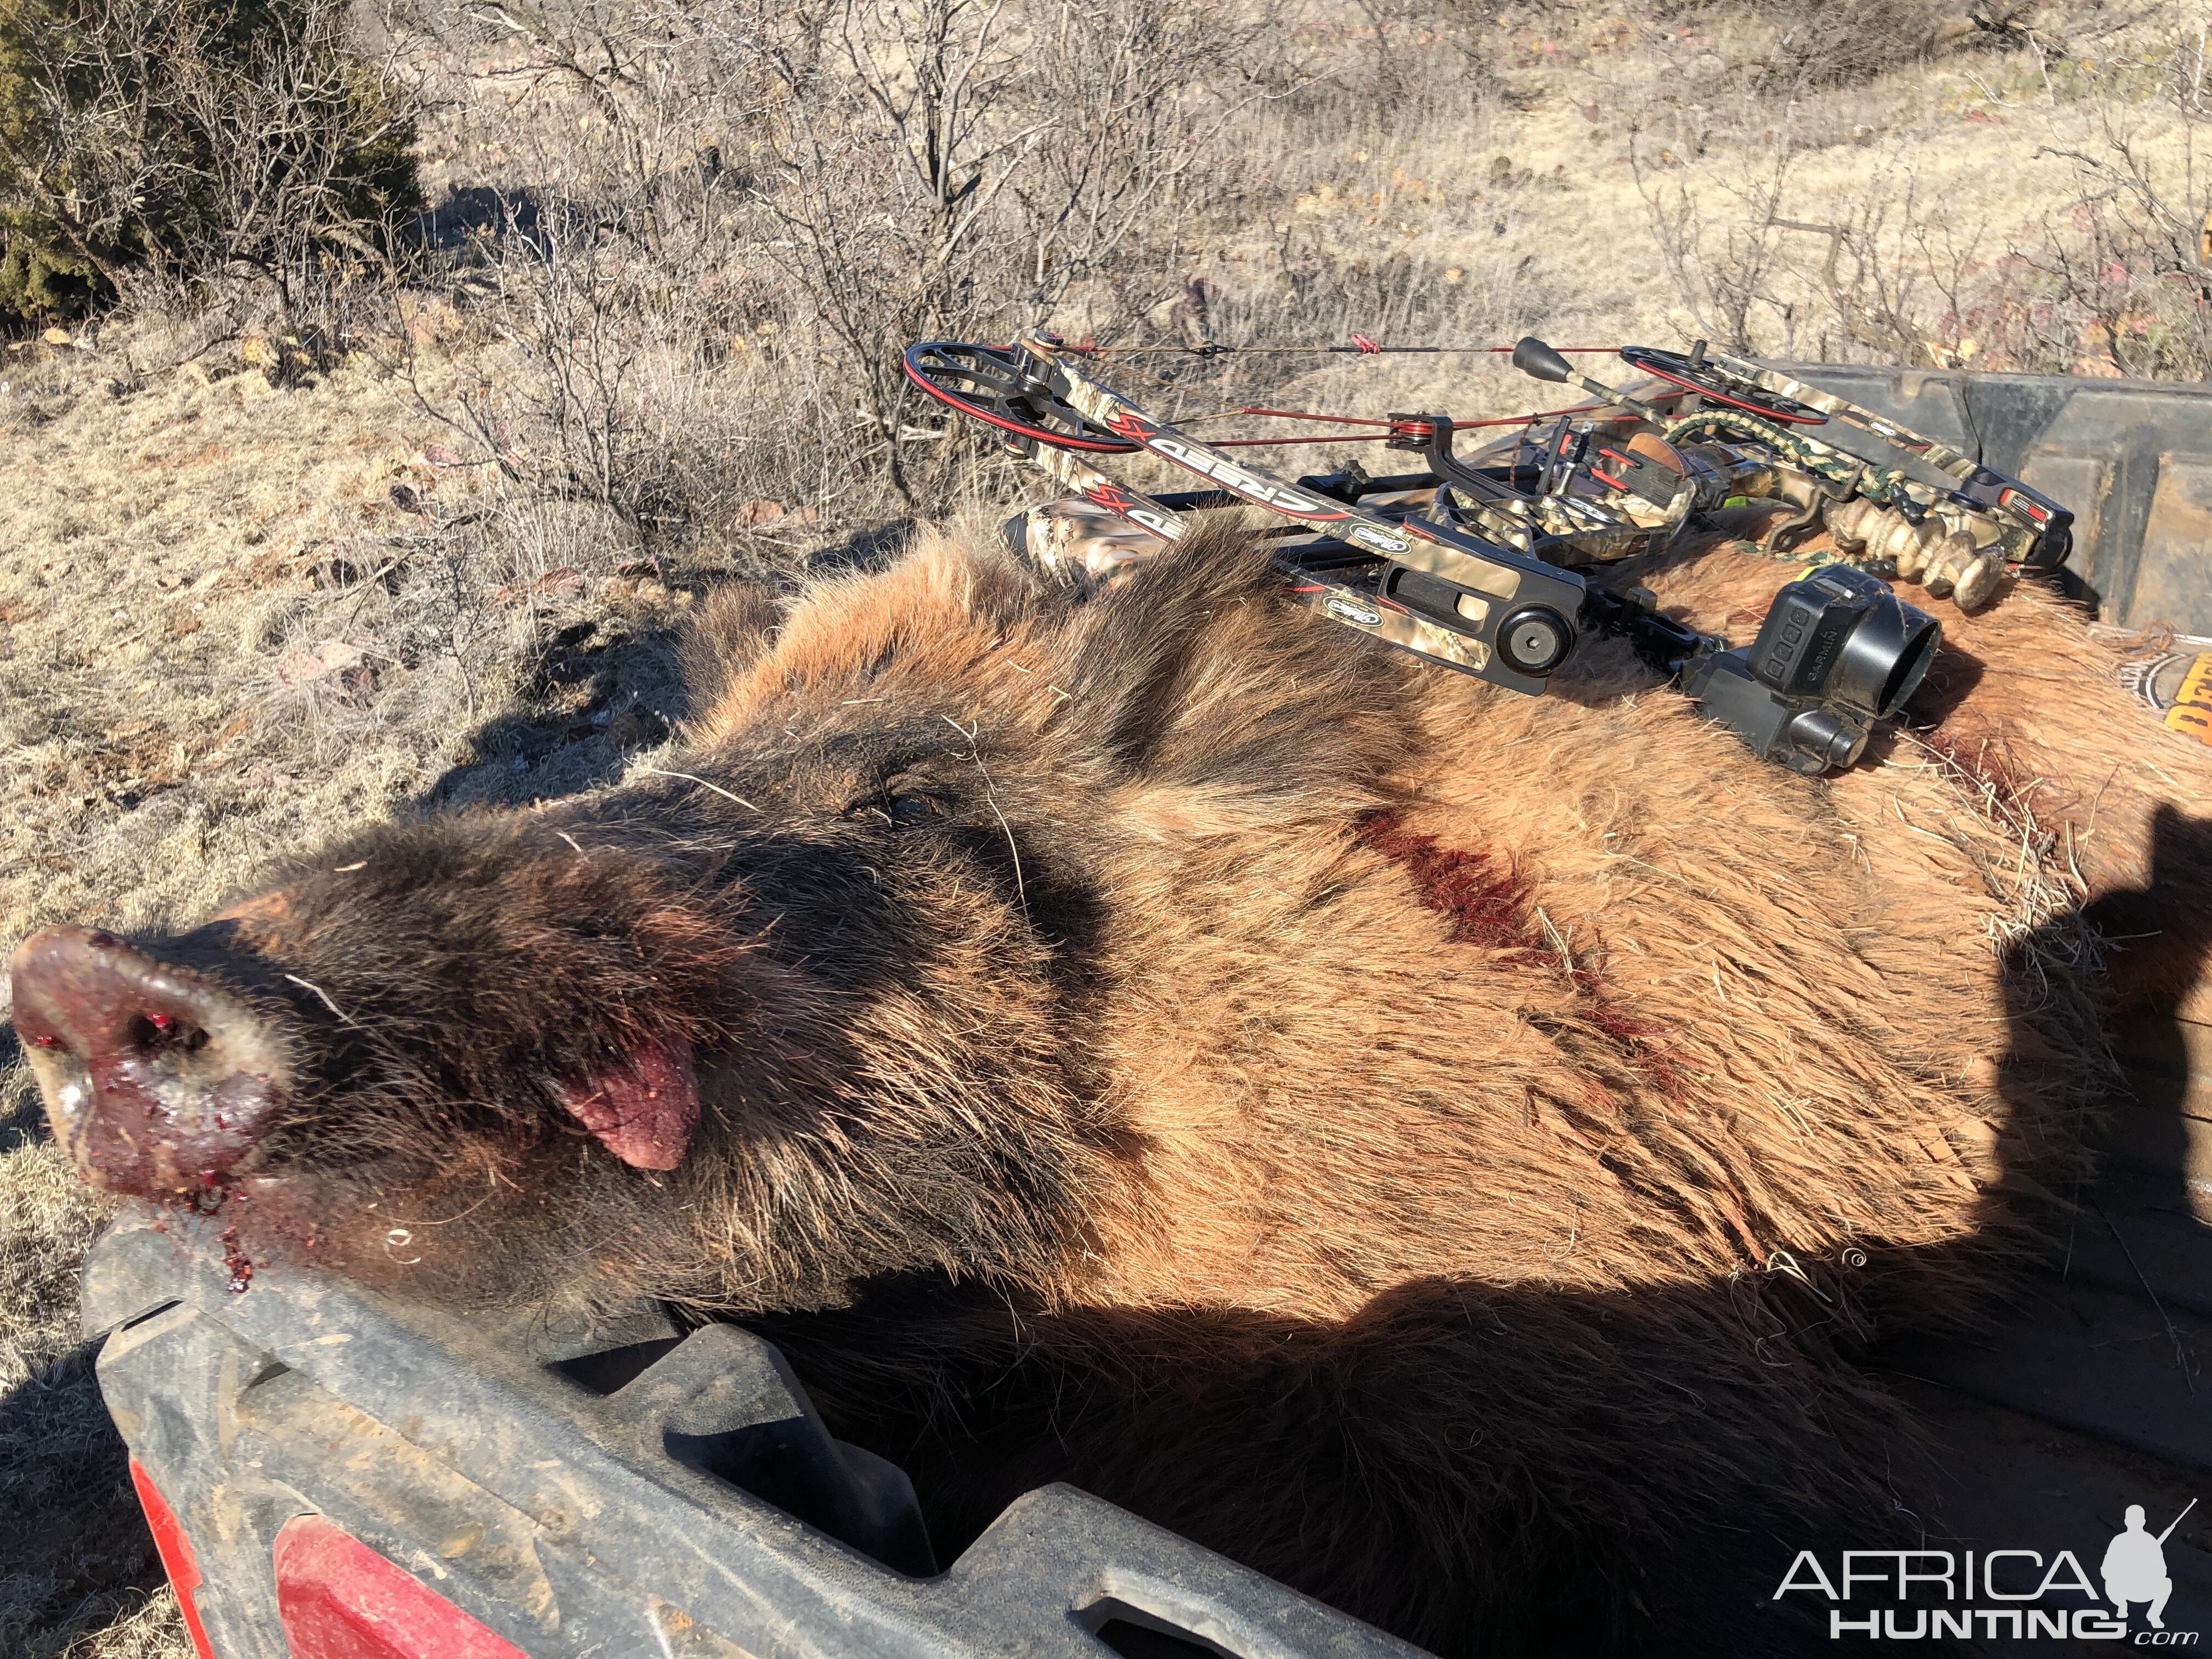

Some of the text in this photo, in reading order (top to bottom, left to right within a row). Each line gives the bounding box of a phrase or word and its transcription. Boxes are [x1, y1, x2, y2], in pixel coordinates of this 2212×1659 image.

[1107, 411, 1319, 512] CREED XS
[1084, 483, 1135, 513] XS
[1367, 527, 1398, 539] SOLOCAM
[1808, 630, 1837, 682] GARMIN
